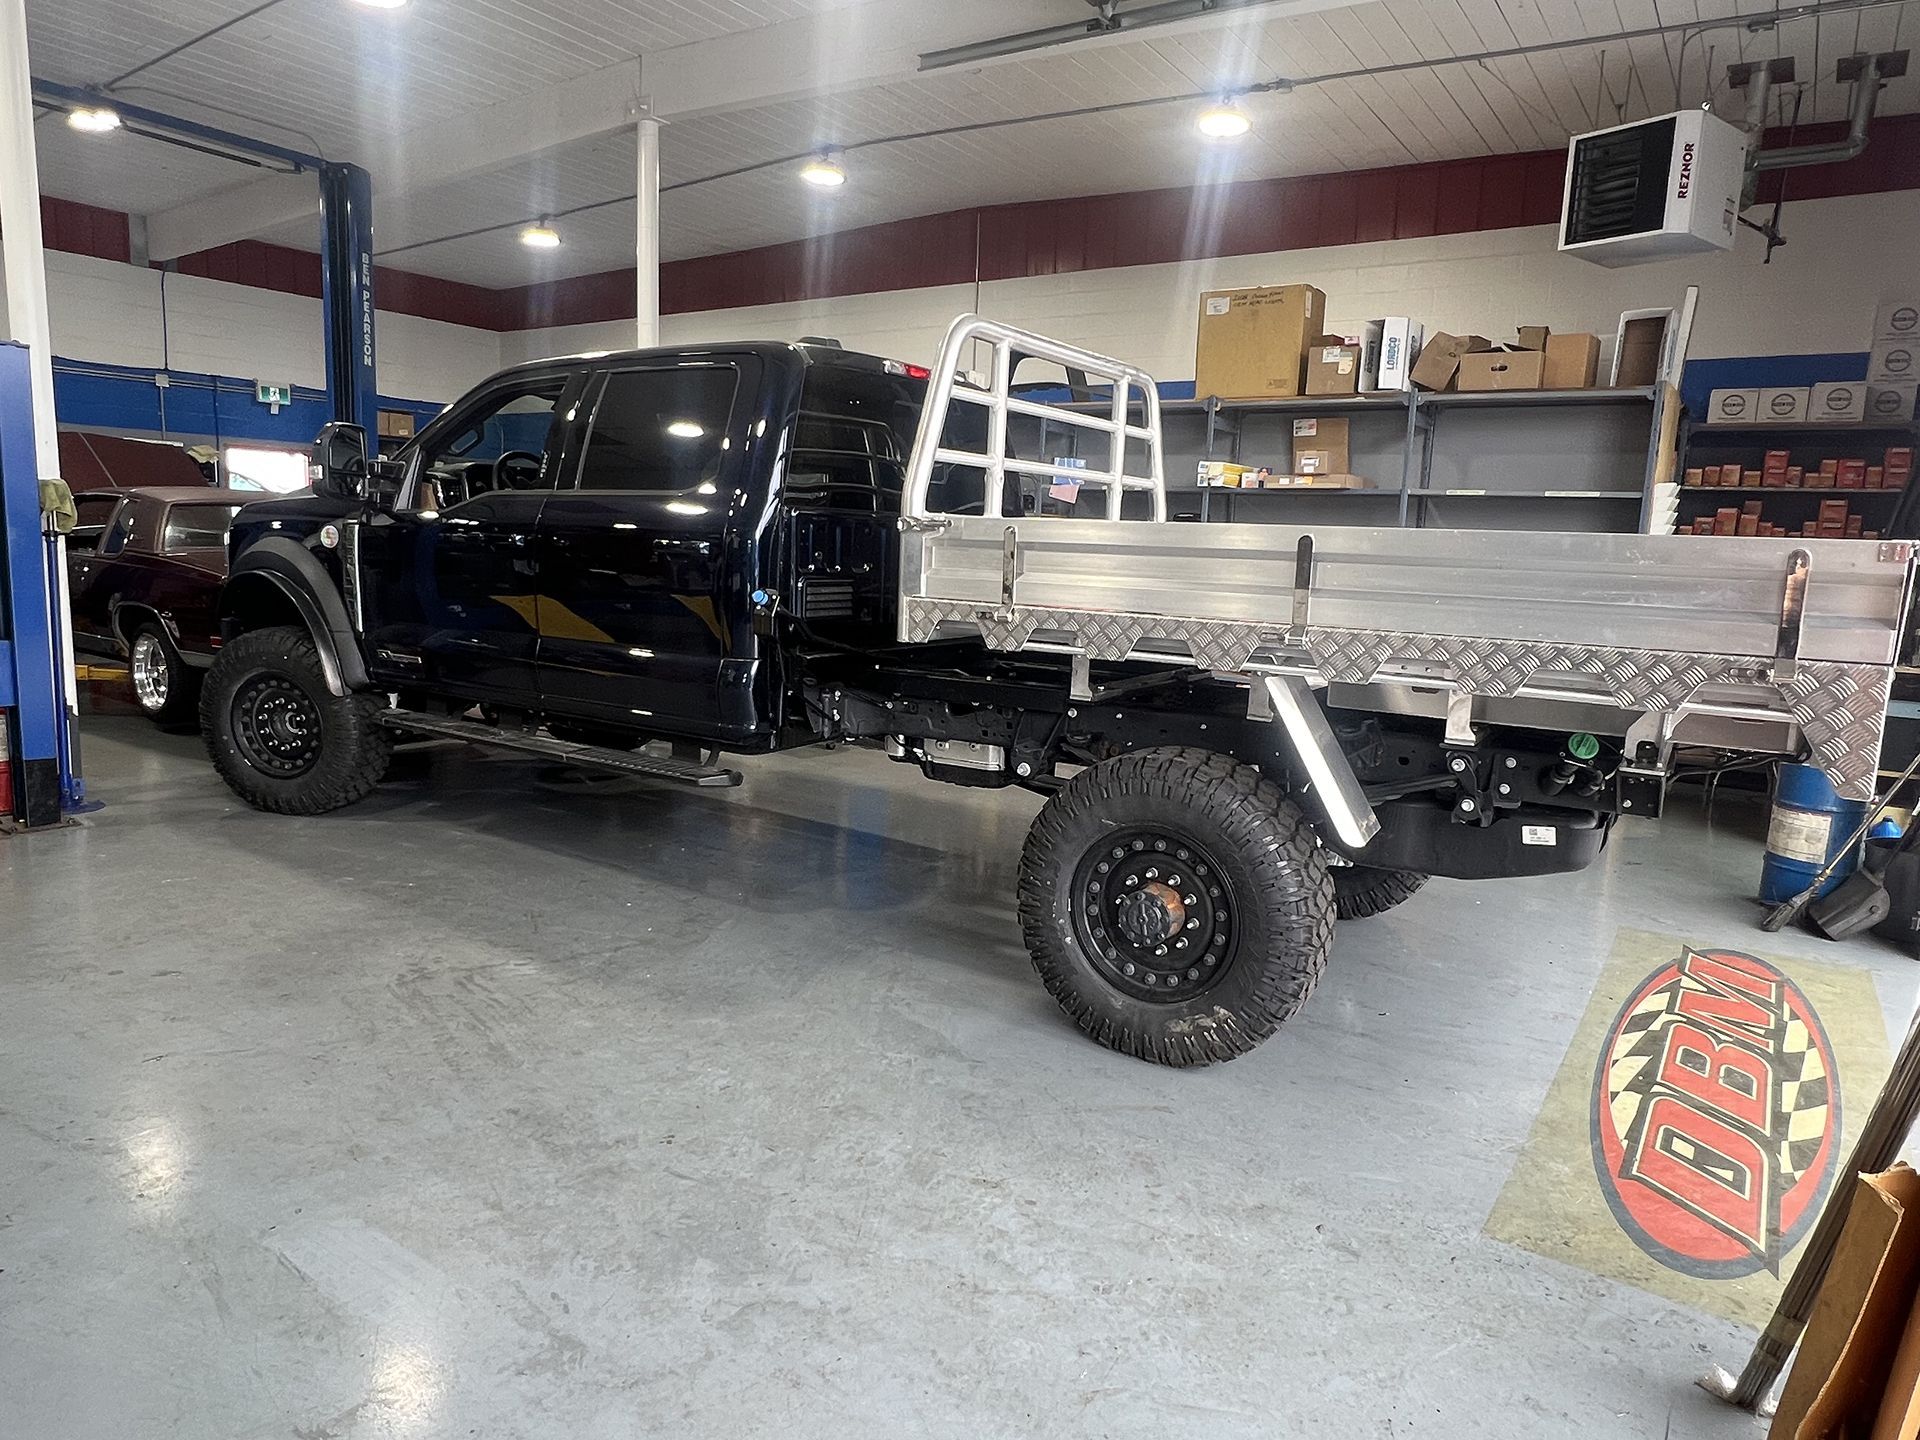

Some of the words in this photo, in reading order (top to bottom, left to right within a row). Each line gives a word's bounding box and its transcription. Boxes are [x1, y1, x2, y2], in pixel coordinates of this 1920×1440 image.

[1678, 143, 1695, 199] REZNOR
[361, 253, 370, 287] BEN
[362, 290, 372, 366] PEARSON
[1386, 336, 1398, 370] LORDCO
[1629, 949, 1778, 1255] DBM
